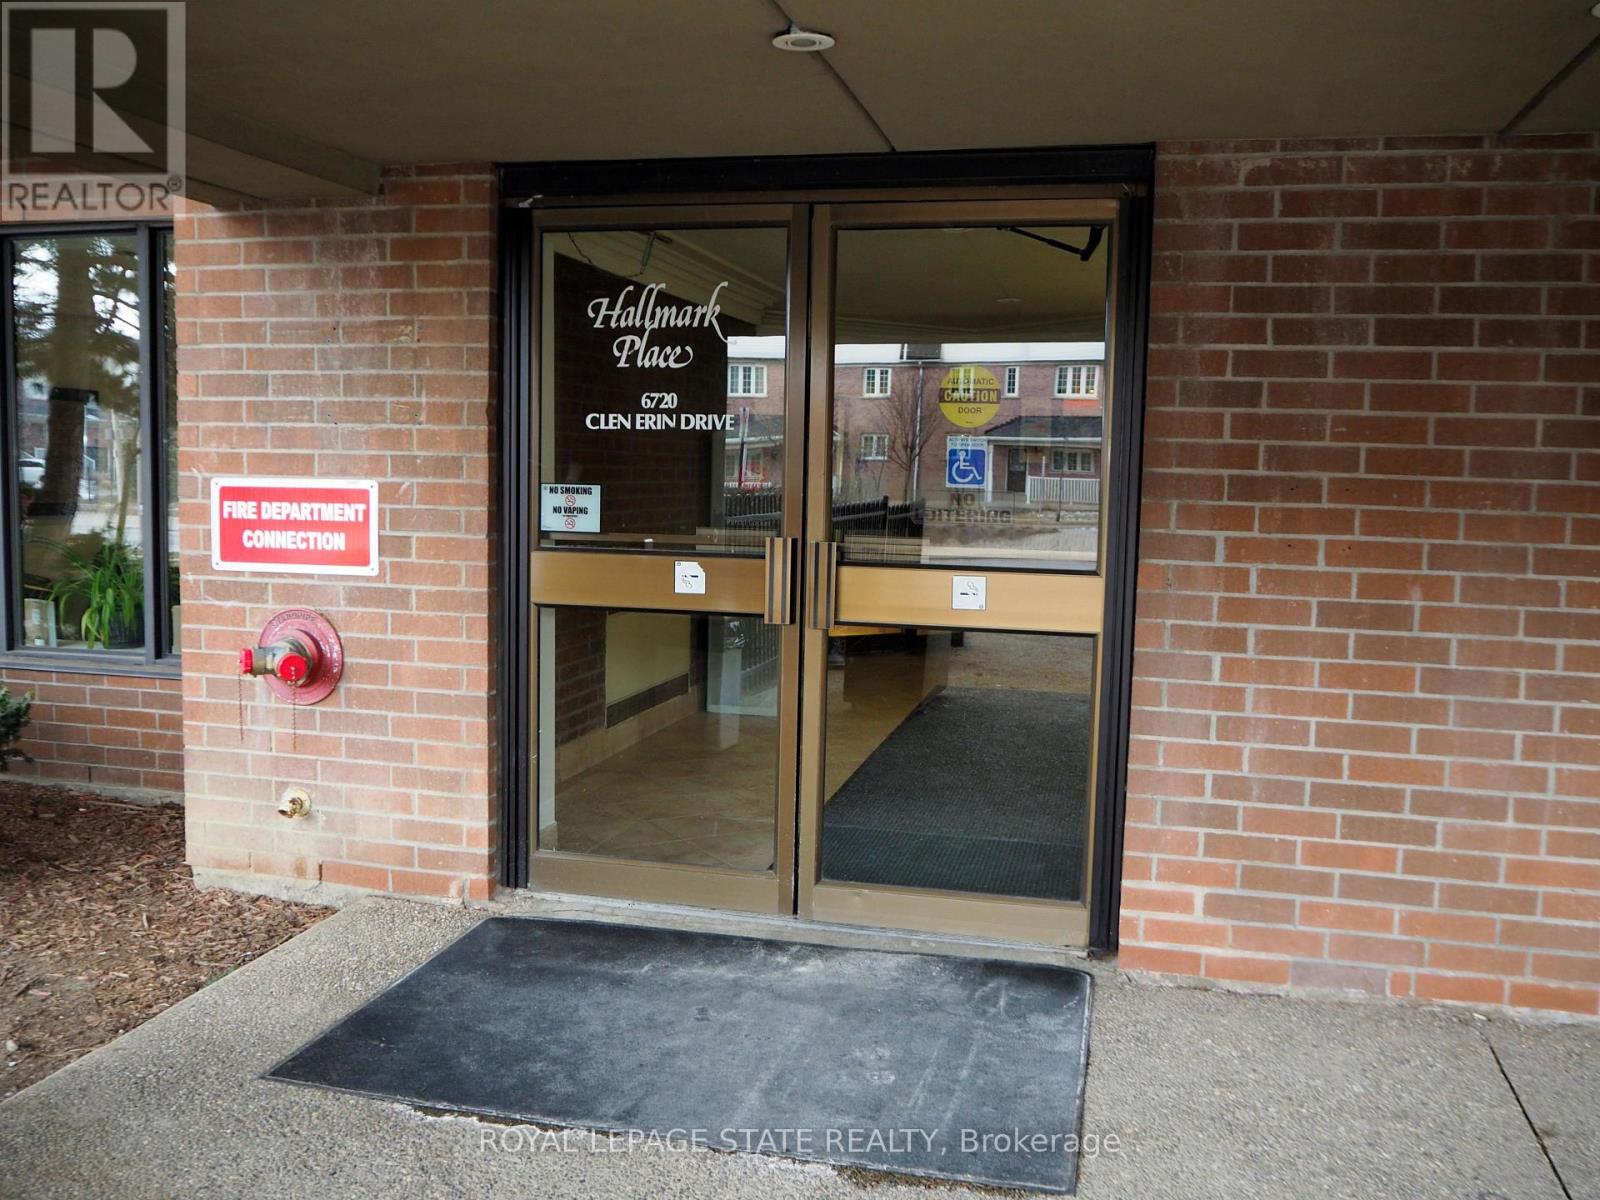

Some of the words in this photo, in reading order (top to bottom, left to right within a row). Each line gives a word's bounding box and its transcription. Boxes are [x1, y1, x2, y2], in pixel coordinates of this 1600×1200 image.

[587, 281, 737, 344] Hallmark
[612, 326, 694, 368] Place
[641, 392, 678, 409] 6720
[944, 390, 998, 402] CAUTION
[957, 406, 982, 415] DOOR
[635, 413, 676, 430] ERIN
[680, 414, 735, 431] DRIVE
[549, 486, 559, 494] NO
[560, 486, 593, 495] SMOKING
[950, 493, 975, 506] NO
[223, 500, 257, 519] FIRE
[260, 501, 366, 522] DEPARTMENT
[552, 506, 562, 514] NO
[563, 506, 588, 515] VAPING
[242, 529, 346, 551] CONNECTION
